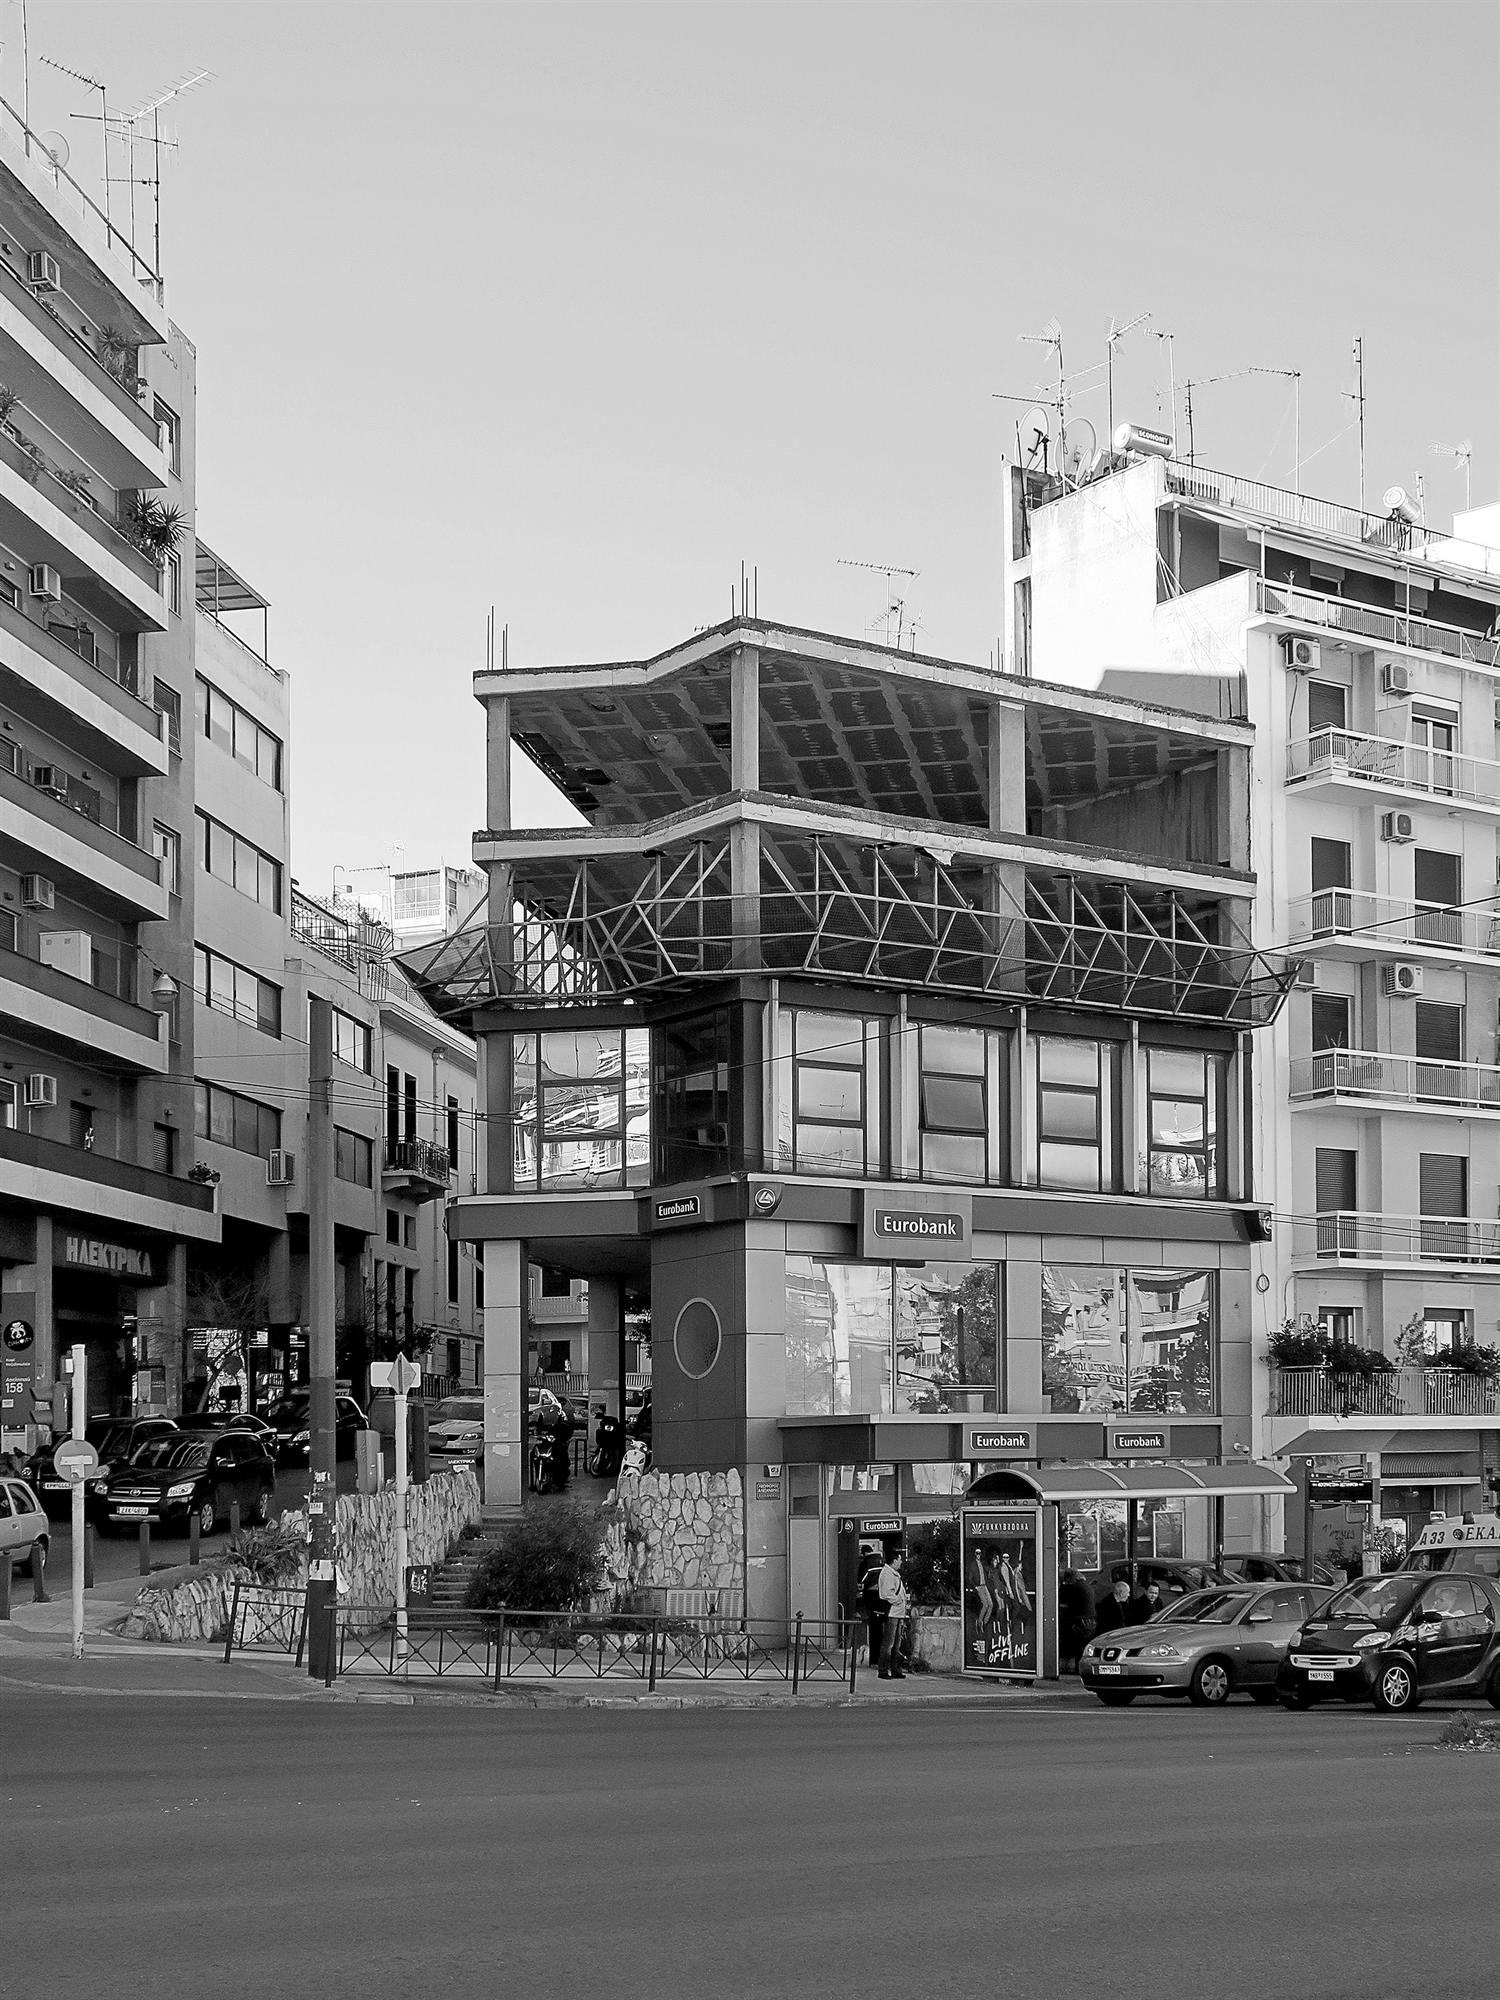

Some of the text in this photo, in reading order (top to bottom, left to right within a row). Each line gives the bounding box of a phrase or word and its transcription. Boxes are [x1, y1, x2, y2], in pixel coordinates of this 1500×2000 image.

[658, 1200, 695, 1216] Eurobank
[883, 1216, 957, 1235] Eurobank
[66, 1236, 152, 1276] ΗΛΕΚΤΡΙΚΑ
[5, 1382, 24, 1393] 158
[976, 1434, 1026, 1447] Eurobank
[1119, 1436, 1161, 1447] Eurobank
[865, 1521, 898, 1530] Eurobank
[1429, 1531, 1446, 1545] 33
[991, 1634, 1012, 1650] LIVE
[988, 1642, 1029, 1663] OFFLINE
